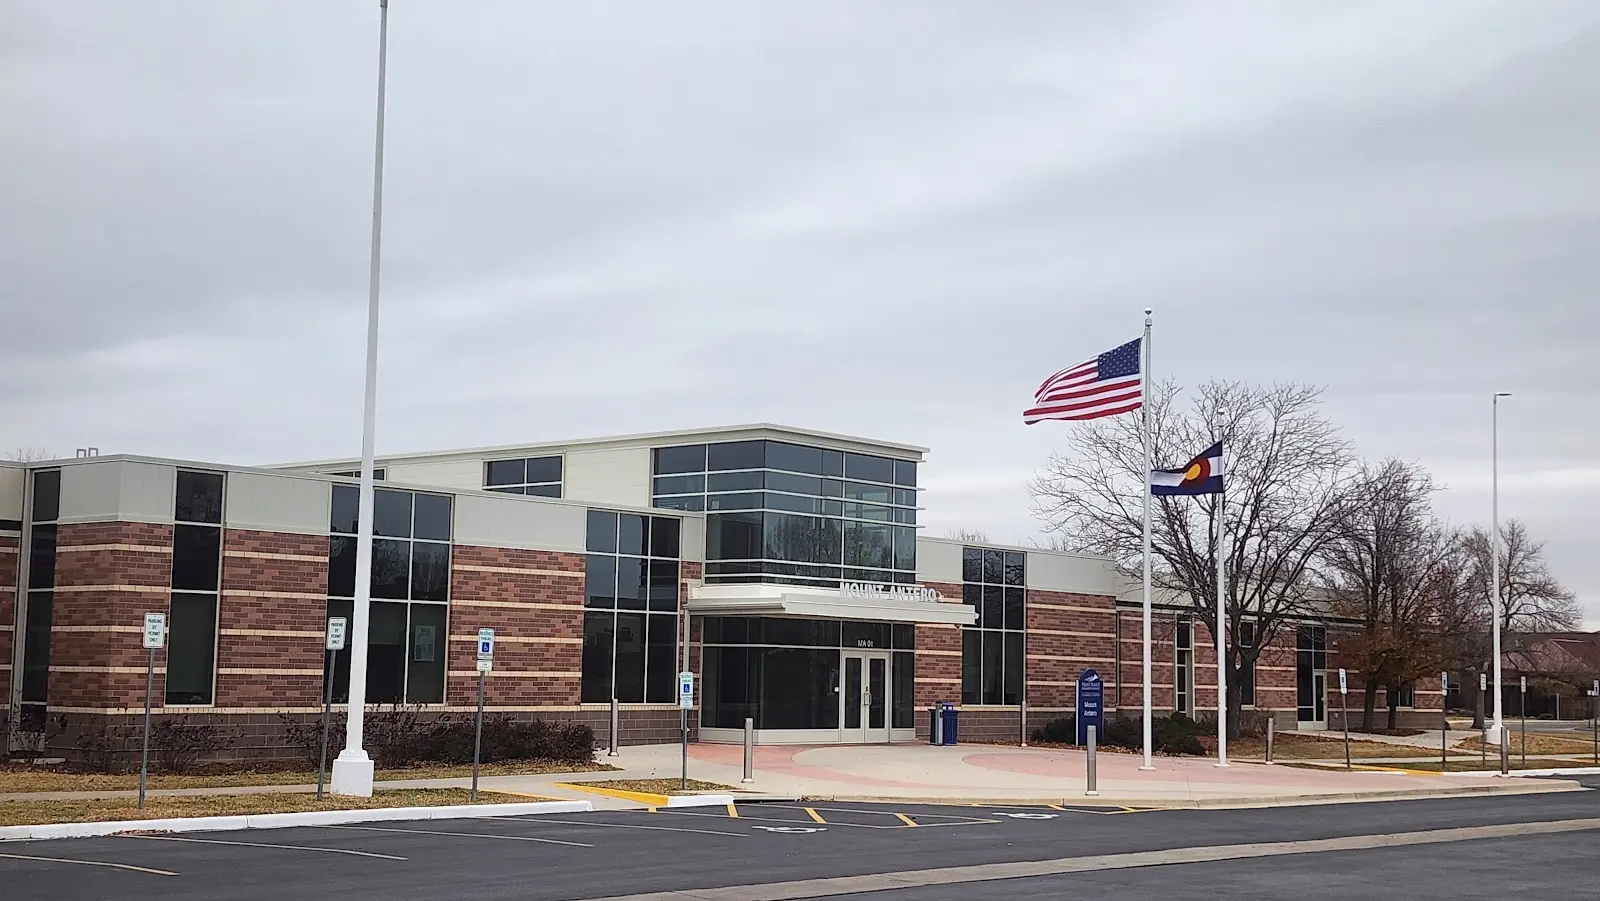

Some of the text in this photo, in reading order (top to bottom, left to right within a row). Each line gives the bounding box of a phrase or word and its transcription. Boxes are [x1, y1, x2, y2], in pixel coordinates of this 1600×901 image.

[840, 582, 937, 602] MOUNT ANTERO
[1084, 709, 1098, 717] Antero
